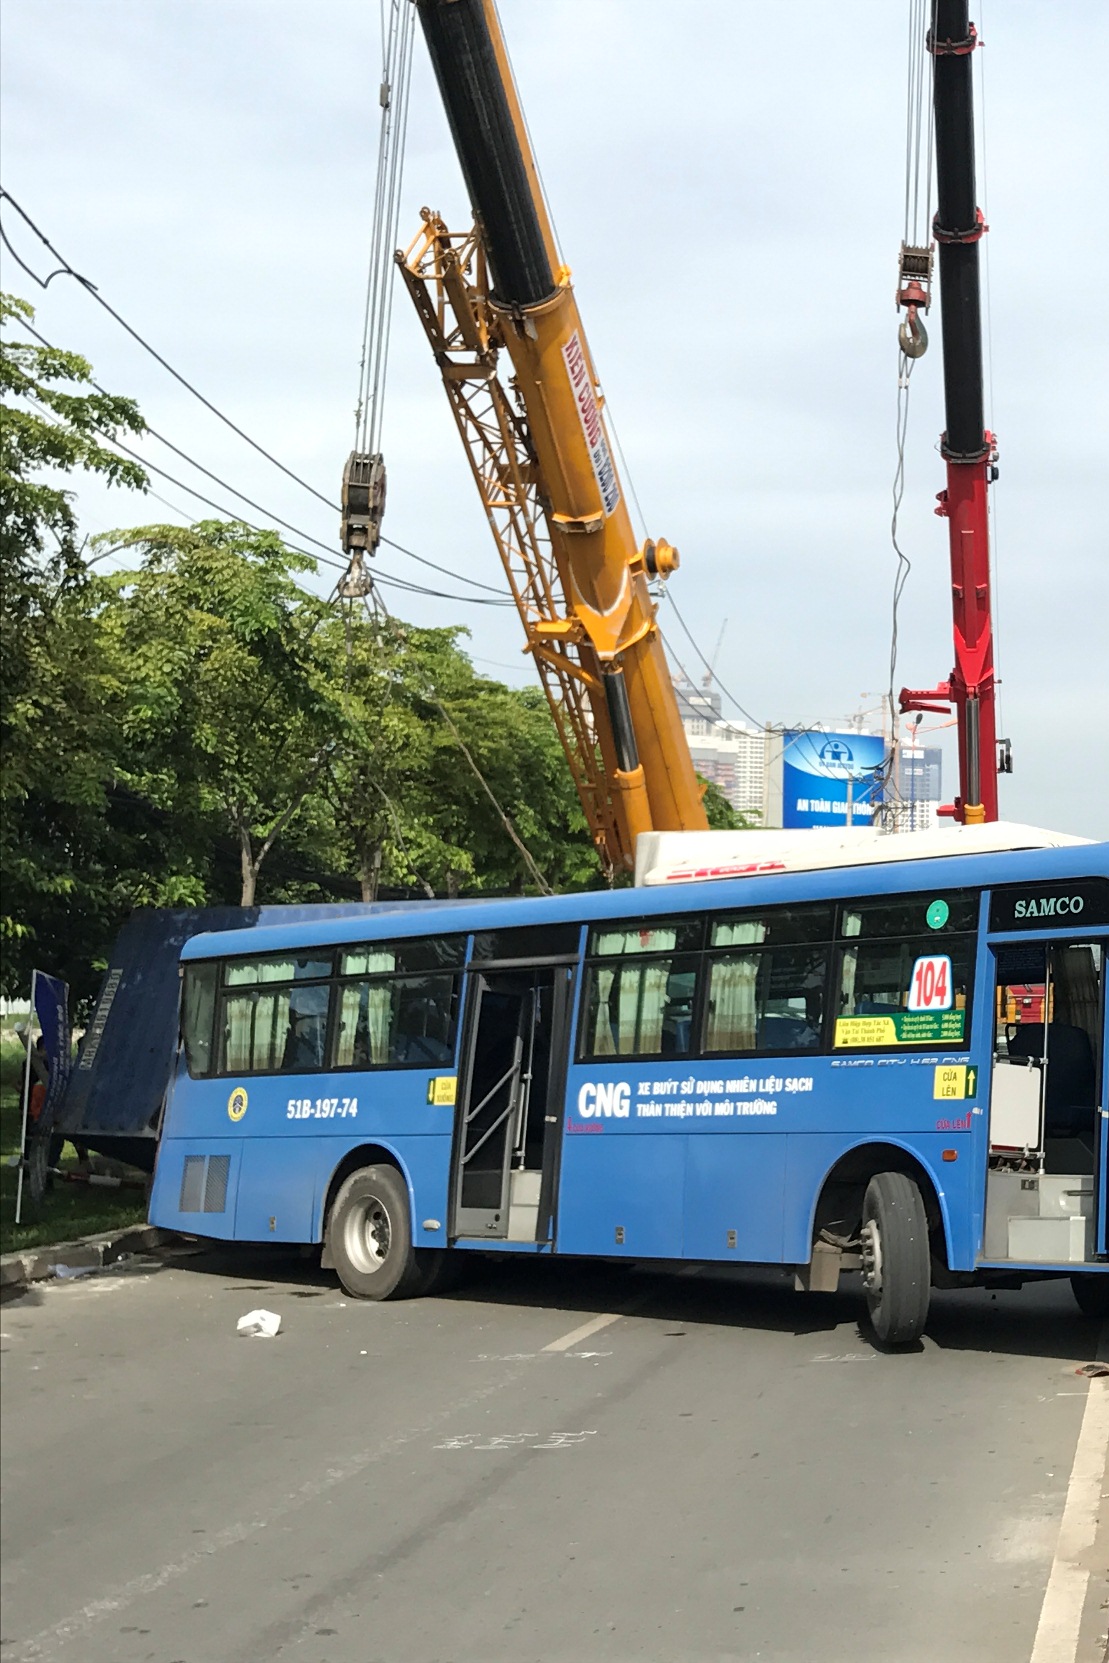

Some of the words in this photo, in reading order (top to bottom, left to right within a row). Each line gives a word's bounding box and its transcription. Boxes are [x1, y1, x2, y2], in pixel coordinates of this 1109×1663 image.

[796, 798, 809, 811] AN
[810, 797, 831, 813] TOÀN
[832, 800, 851, 814] GIA
[1014, 896, 1084, 918] SAMCO
[916, 960, 947, 1007] 104
[637, 1081, 651, 1095] XE
[652, 1078, 679, 1095] BUÝT
[680, 1075, 696, 1094] SỬ
[696, 1080, 724, 1096] DỤNG
[725, 1075, 758, 1093] NHIÊN
[758, 1075, 784, 1095] LIỆU
[784, 1077, 814, 1095] SẠCH
[941, 1084, 957, 1097] LÊN
[286, 1097, 358, 1119] 51B-197-74
[578, 1081, 632, 1118] CNG
[636, 1100, 662, 1117] THÂN
[664, 1099, 694, 1119] THIỆN
[714, 1098, 735, 1116] MÔI
[736, 1097, 778, 1116] TRƯỜNG
